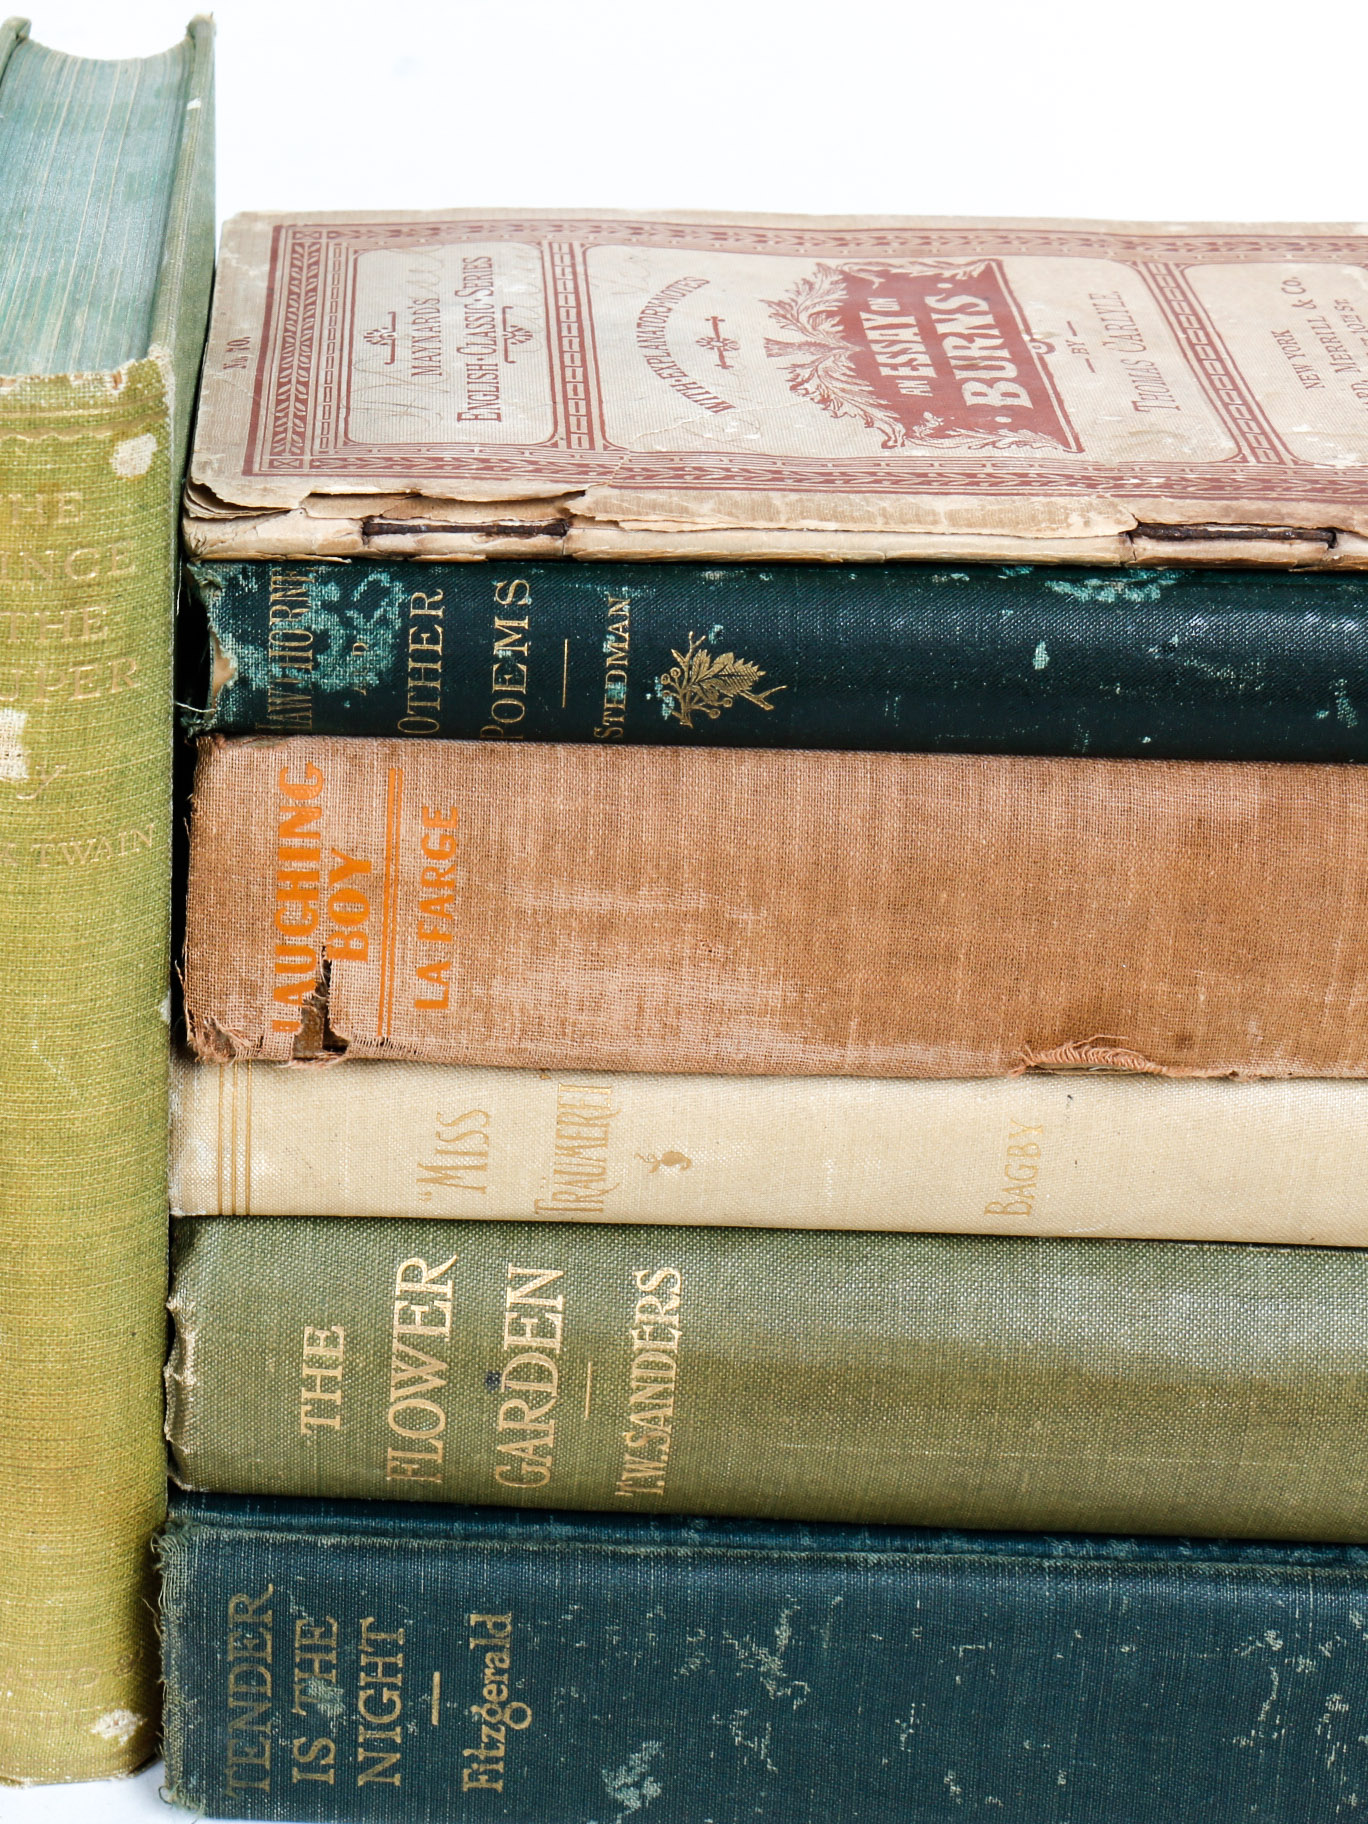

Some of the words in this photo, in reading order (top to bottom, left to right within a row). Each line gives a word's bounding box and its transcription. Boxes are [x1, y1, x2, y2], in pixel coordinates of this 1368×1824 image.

[407, 297, 443, 378] MAYNARD'S
[859, 311, 938, 378] ESSAY
[866, 298, 901, 311] ON
[923, 293, 1034, 410] BURNS
[1087, 290, 1147, 353] CARLYLE
[1270, 328, 1307, 361] YORK
[1291, 298, 1318, 310] &
[1305, 315, 1362, 374] MERRILL
[895, 379, 934, 397] AN
[1119, 358, 1182, 413] THOMAS
[1291, 363, 1326, 390] NEW
[396, 588, 446, 735] OTHER
[479, 579, 531, 740] POEMS
[593, 590, 632, 740] STEDMAN
[30, 823, 157, 867] TWAIN
[417, 805, 460, 943] FARGE
[327, 847, 372, 963] BOY
[414, 960, 452, 1011] LA
[983, 1118, 1044, 1217] BAGBY
[300, 1325, 345, 1436] THE
[386, 1254, 459, 1484] FLOWER
[494, 1262, 566, 1489] GARDEN
[222, 1582, 275, 1799] TENDER
[290, 1614, 339, 1718] THE
[356, 1615, 406, 1788] NIGHT
[462, 1610, 533, 1793] Fitzgerald
[291, 1736, 337, 1786] IS
